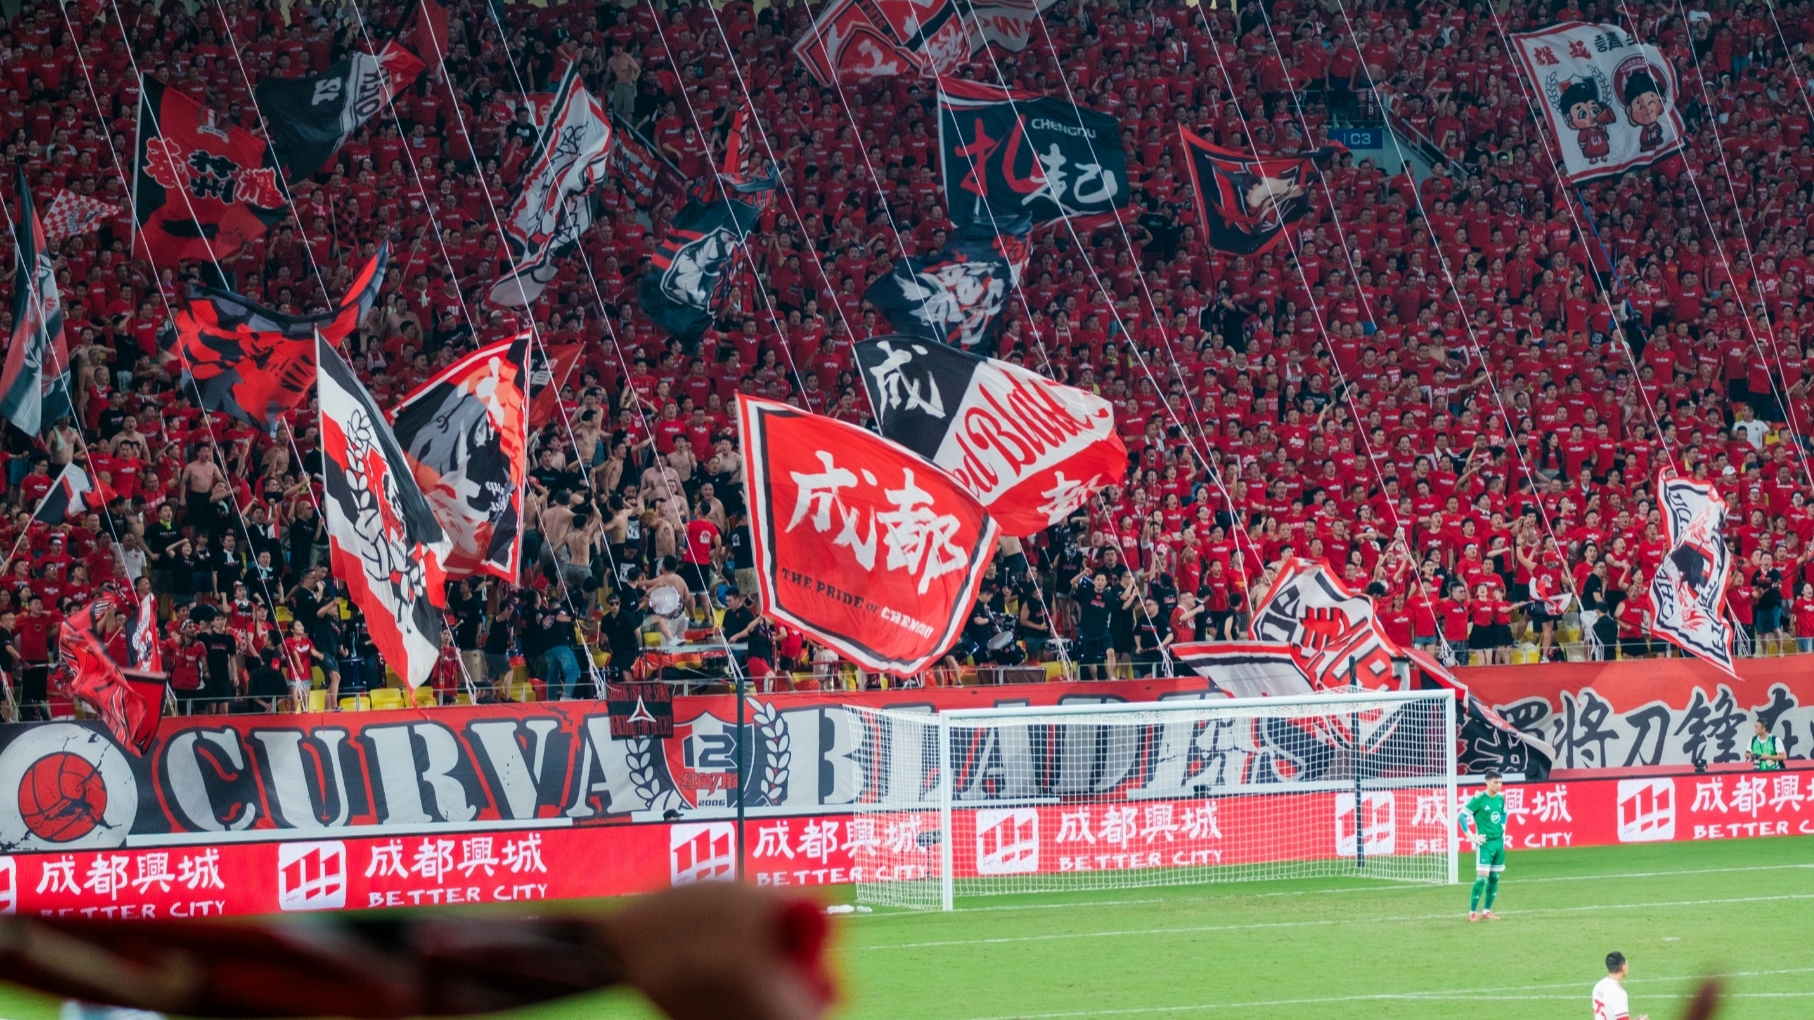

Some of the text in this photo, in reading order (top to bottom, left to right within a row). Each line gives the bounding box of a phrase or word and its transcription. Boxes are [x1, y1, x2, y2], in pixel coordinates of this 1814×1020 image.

[1031, 118, 1097, 139] CHENGDU
[1350, 133, 1371, 145] C3
[869, 339, 947, 419] 成
[784, 449, 968, 597] 成都
[781, 568, 812, 589] THE
[816, 580, 864, 610] PRIDE
[682, 734, 738, 768] 12
[164, 719, 624, 832] CURVA
[698, 799, 726, 807] 2006
[753, 815, 928, 865] 成都興城
[1056, 801, 1223, 850] 成都興城
[1525, 831, 1574, 849] CITY
[1692, 820, 1789, 840] BETTER
[35, 847, 226, 902] 成都興城
[364, 833, 548, 886] 成都興城
[1058, 848, 1224, 872] BETTER CITY
[756, 863, 928, 887] BETTER CITY
[169, 899, 226, 919] CITY
[368, 882, 549, 908] BETTER CITY
